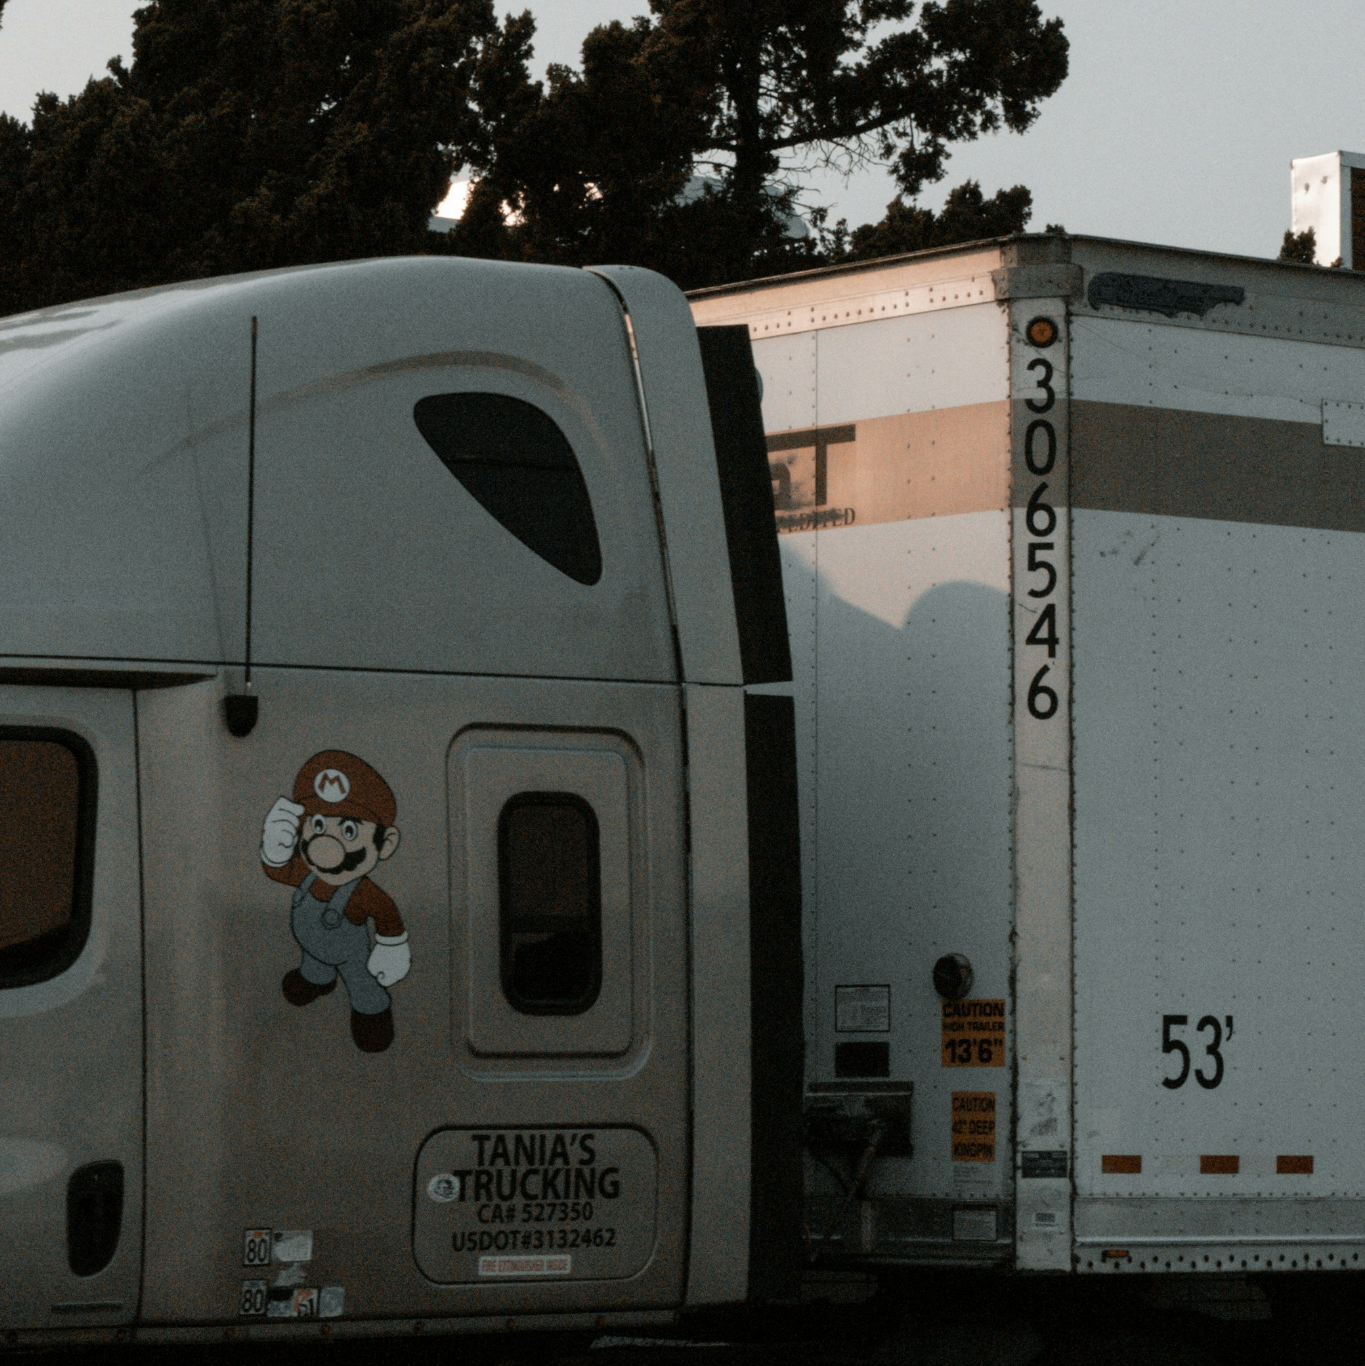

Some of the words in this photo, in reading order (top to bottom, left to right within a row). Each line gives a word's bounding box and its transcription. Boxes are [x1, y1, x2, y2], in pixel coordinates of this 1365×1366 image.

[1024, 358, 1060, 720] 306546
[318, 772, 346, 794] M
[942, 1002, 1005, 1018] CAUTION
[942, 1022, 965, 1033] HIGH
[967, 1021, 1005, 1032] TRAILER
[945, 1038, 1003, 1064] 13'6"
[1161, 1014, 1233, 1090] 53'
[953, 1097, 995, 1113] CAUTION
[969, 1119, 995, 1135] DEEP
[471, 1133, 596, 1167] TANIA'S
[954, 1142, 993, 1157] KINGPIN
[453, 1166, 619, 1202] TRUCKING
[478, 1204, 516, 1224] CA#
[521, 1202, 594, 1223] 527350
[246, 1238, 268, 1263] 80
[453, 1227, 617, 1253] USDOT#3132462
[241, 1288, 264, 1313] 80
